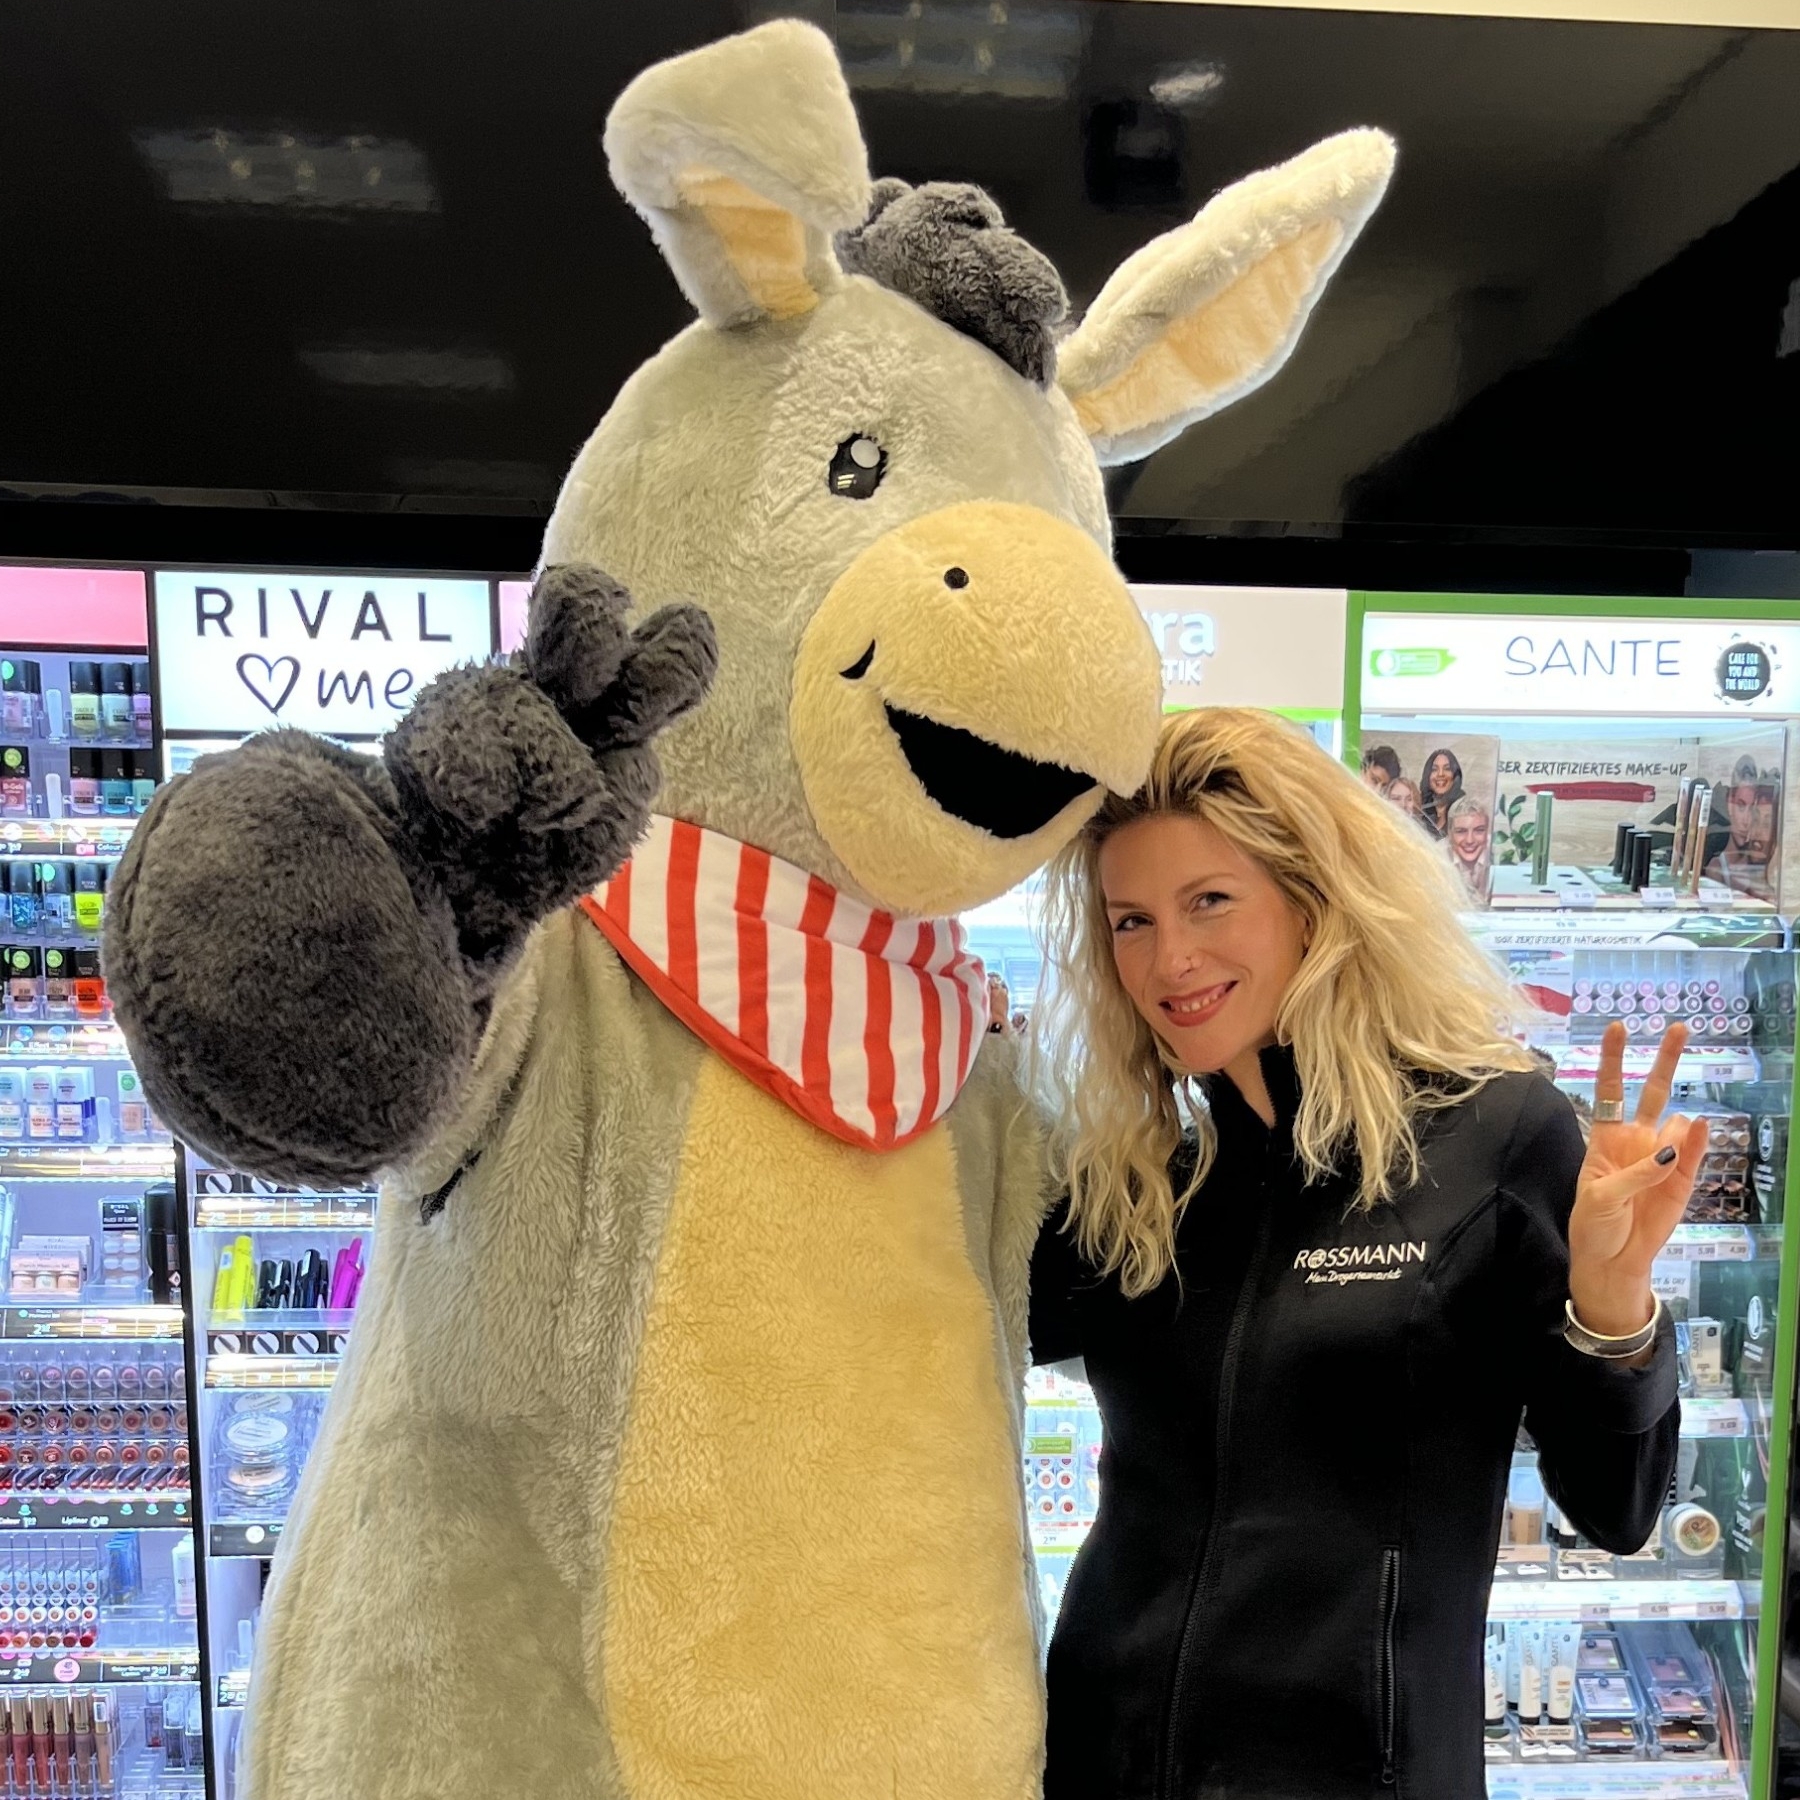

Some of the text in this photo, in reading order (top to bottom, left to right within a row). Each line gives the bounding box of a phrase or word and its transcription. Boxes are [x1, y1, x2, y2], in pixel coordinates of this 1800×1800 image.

[195, 586, 452, 642] RIVAL
[1146, 612, 1216, 656] ra
[1161, 658, 1202, 685] TIK
[1505, 636, 1681, 676] SANTE
[318, 668, 414, 710] me
[1525, 761, 1622, 776] ZERTIFIZIERTES
[1626, 762, 1688, 776] MAKE-UP
[1293, 1241, 1427, 1269] ROSSMANN
